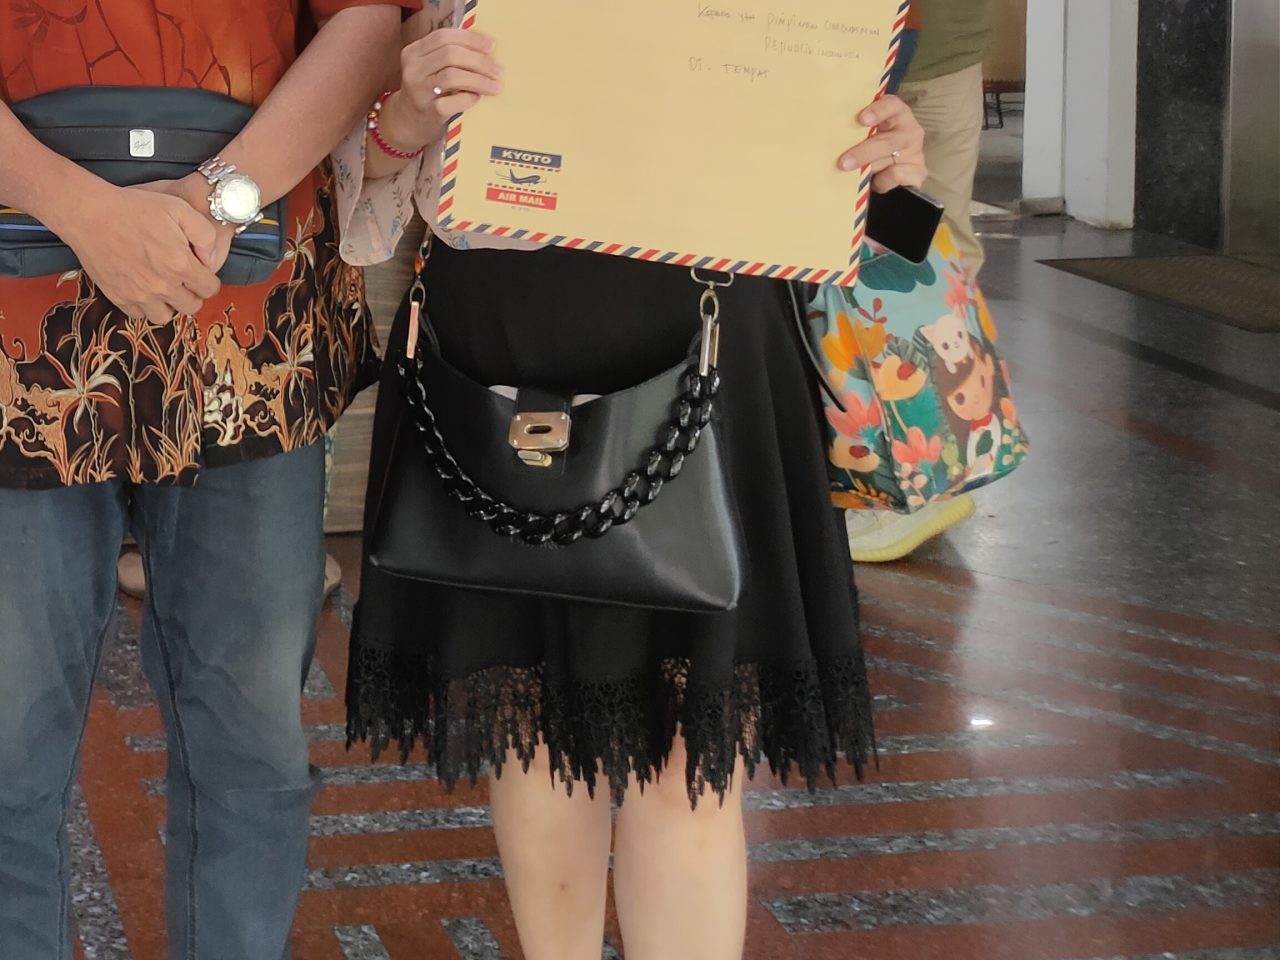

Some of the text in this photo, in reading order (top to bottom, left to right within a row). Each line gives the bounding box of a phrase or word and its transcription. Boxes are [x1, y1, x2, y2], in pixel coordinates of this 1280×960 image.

[501, 150, 552, 164] KYOTO
[497, 192, 545, 206] AIR MAIL
